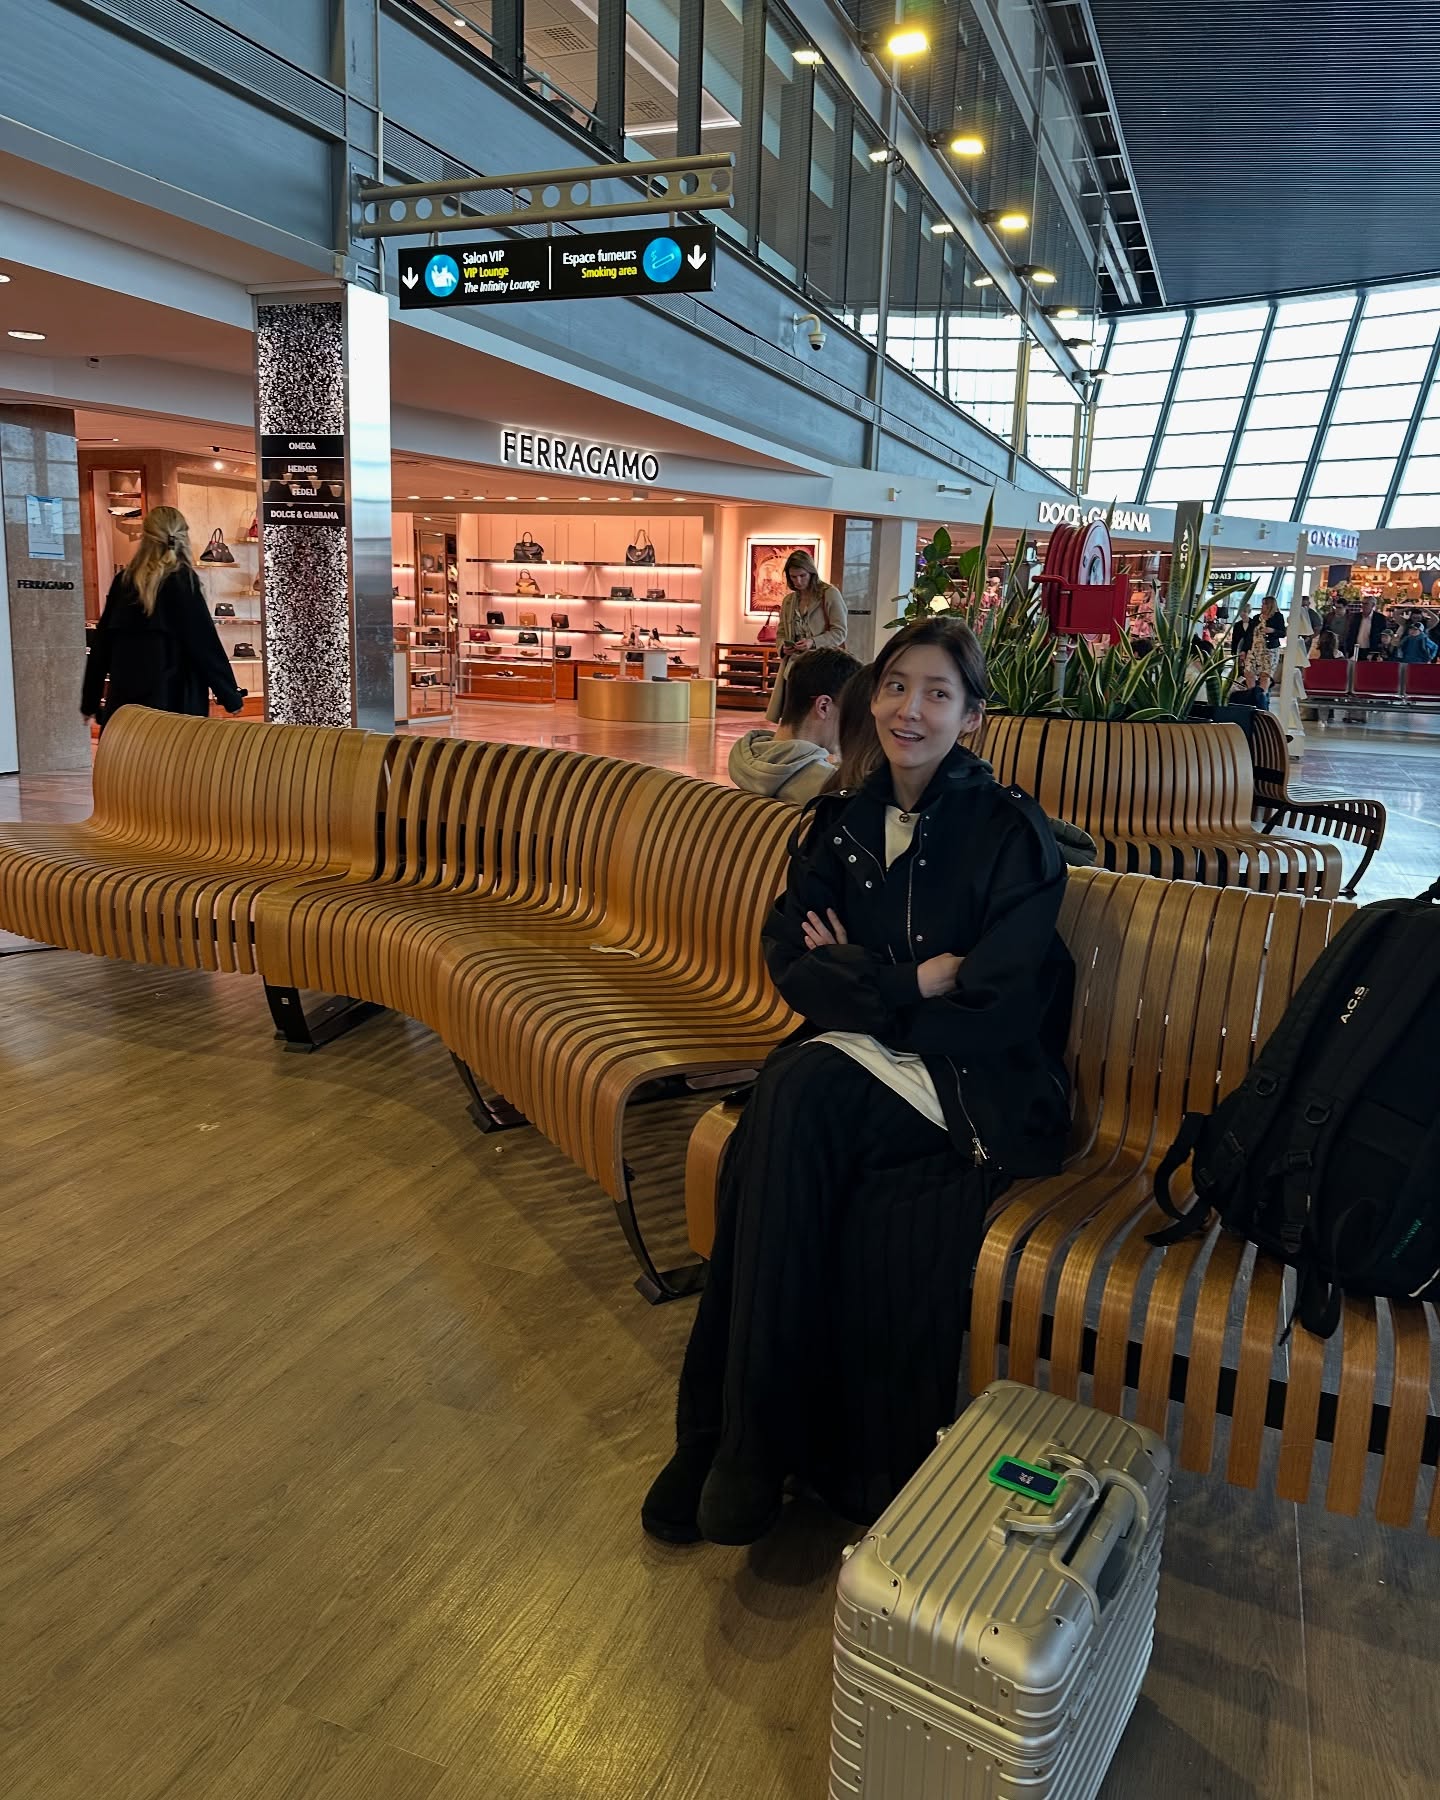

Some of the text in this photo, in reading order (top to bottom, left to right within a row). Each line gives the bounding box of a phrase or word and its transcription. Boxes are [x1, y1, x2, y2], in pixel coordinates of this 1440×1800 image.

[462, 249, 505, 265] Salon VIP
[562, 249, 637, 267] Espace fumeurs
[463, 266, 510, 279] VIP Lounge
[581, 266, 638, 279] Smoking area
[464, 279, 541, 293] The Infinity Lounge
[288, 442, 317, 450] OMEGA
[502, 430, 660, 482] FERRAGAMO
[291, 488, 318, 496] FEDELI
[270, 510, 339, 520] DOLCE & GABBANA
